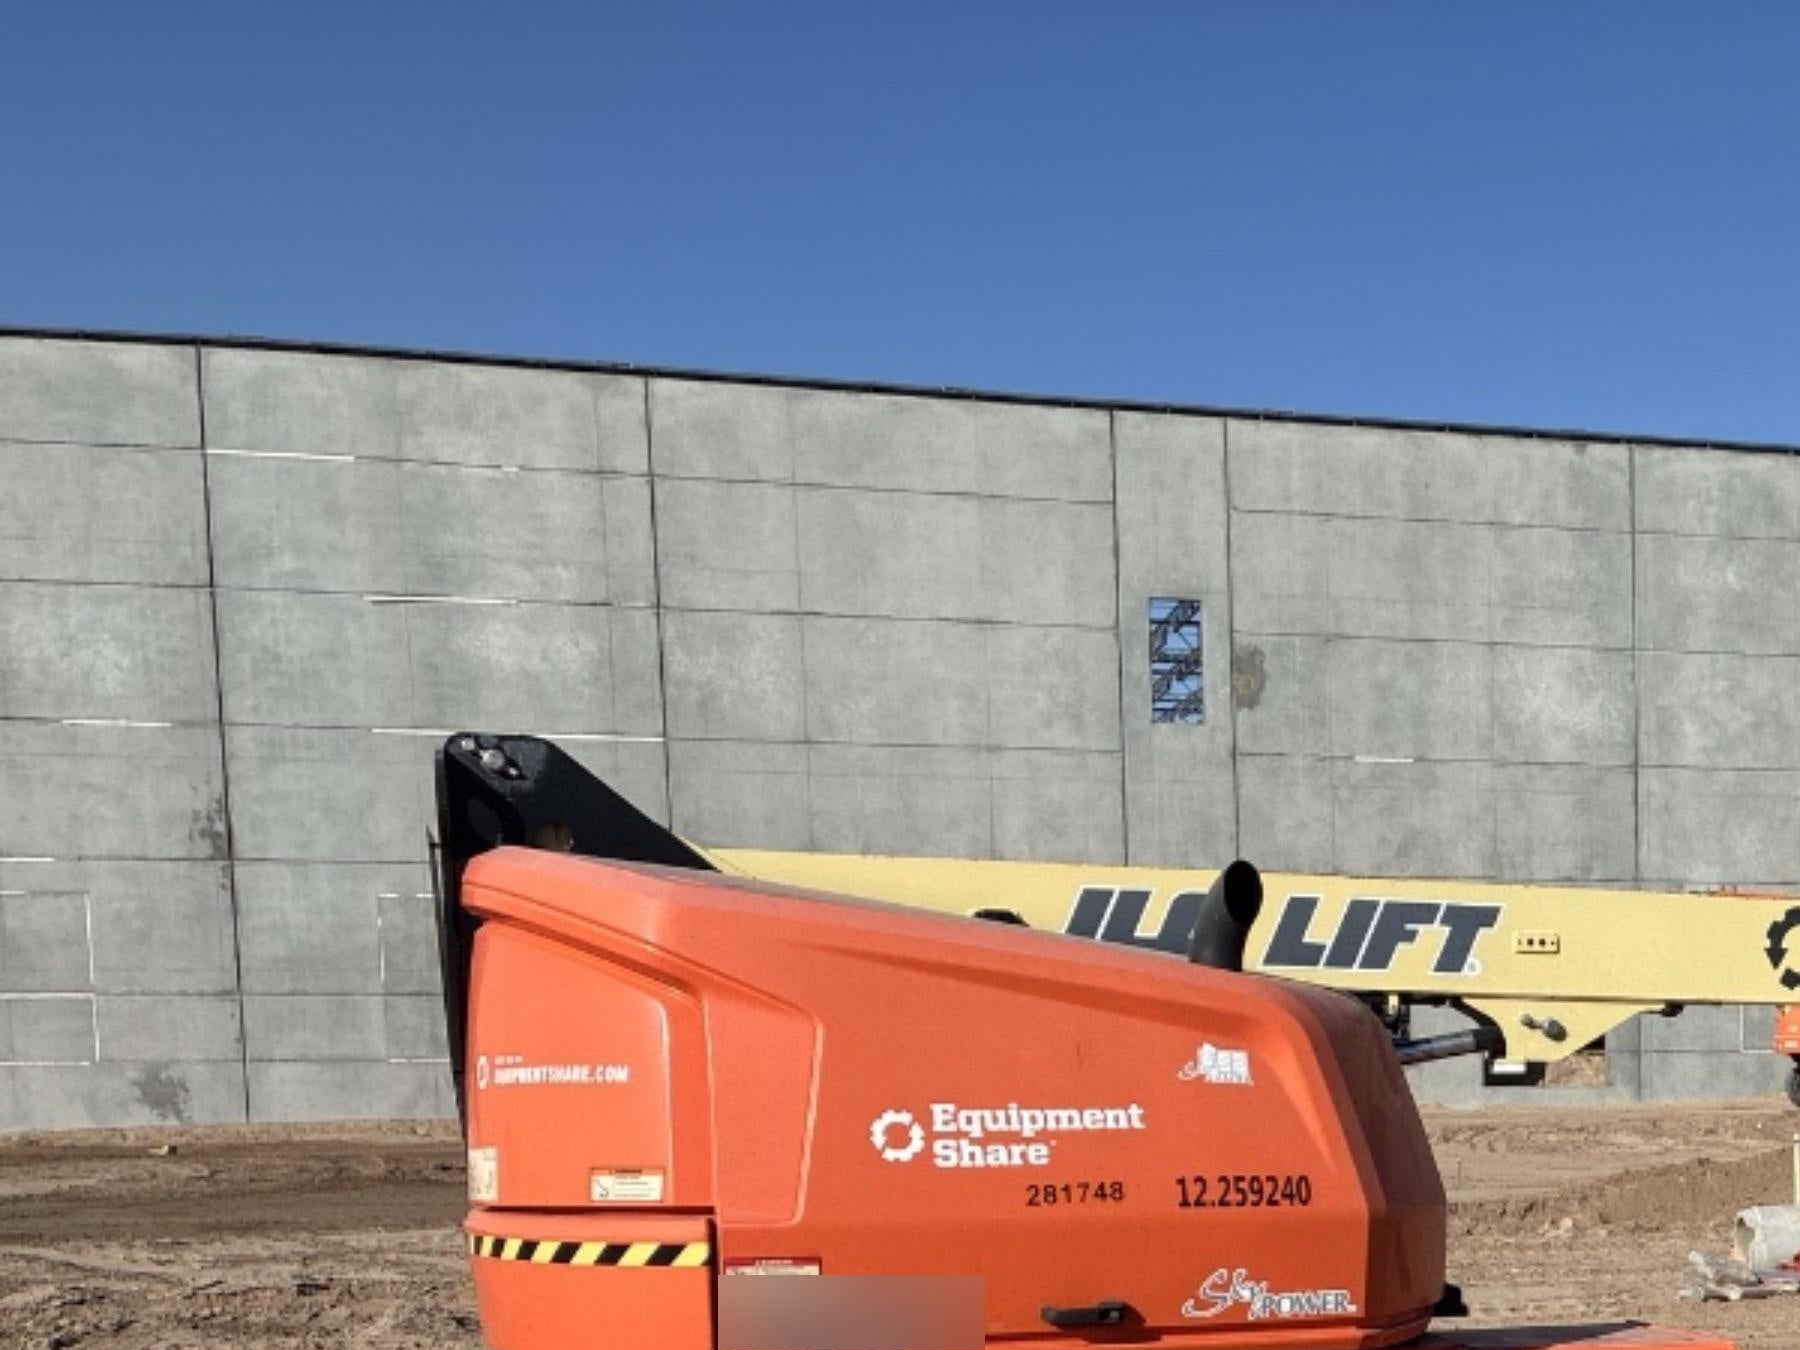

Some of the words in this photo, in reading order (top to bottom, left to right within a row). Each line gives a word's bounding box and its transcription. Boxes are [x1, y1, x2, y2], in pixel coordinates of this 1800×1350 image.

[1261, 895, 1505, 974] LIFT
[494, 1065, 629, 1085] PMENTSHARE.COM
[930, 1103, 1146, 1134] Equipment
[932, 1138, 1051, 1168] Share
[1026, 1181, 1126, 1207] 281748
[1176, 1175, 1313, 1208] 12.259240
